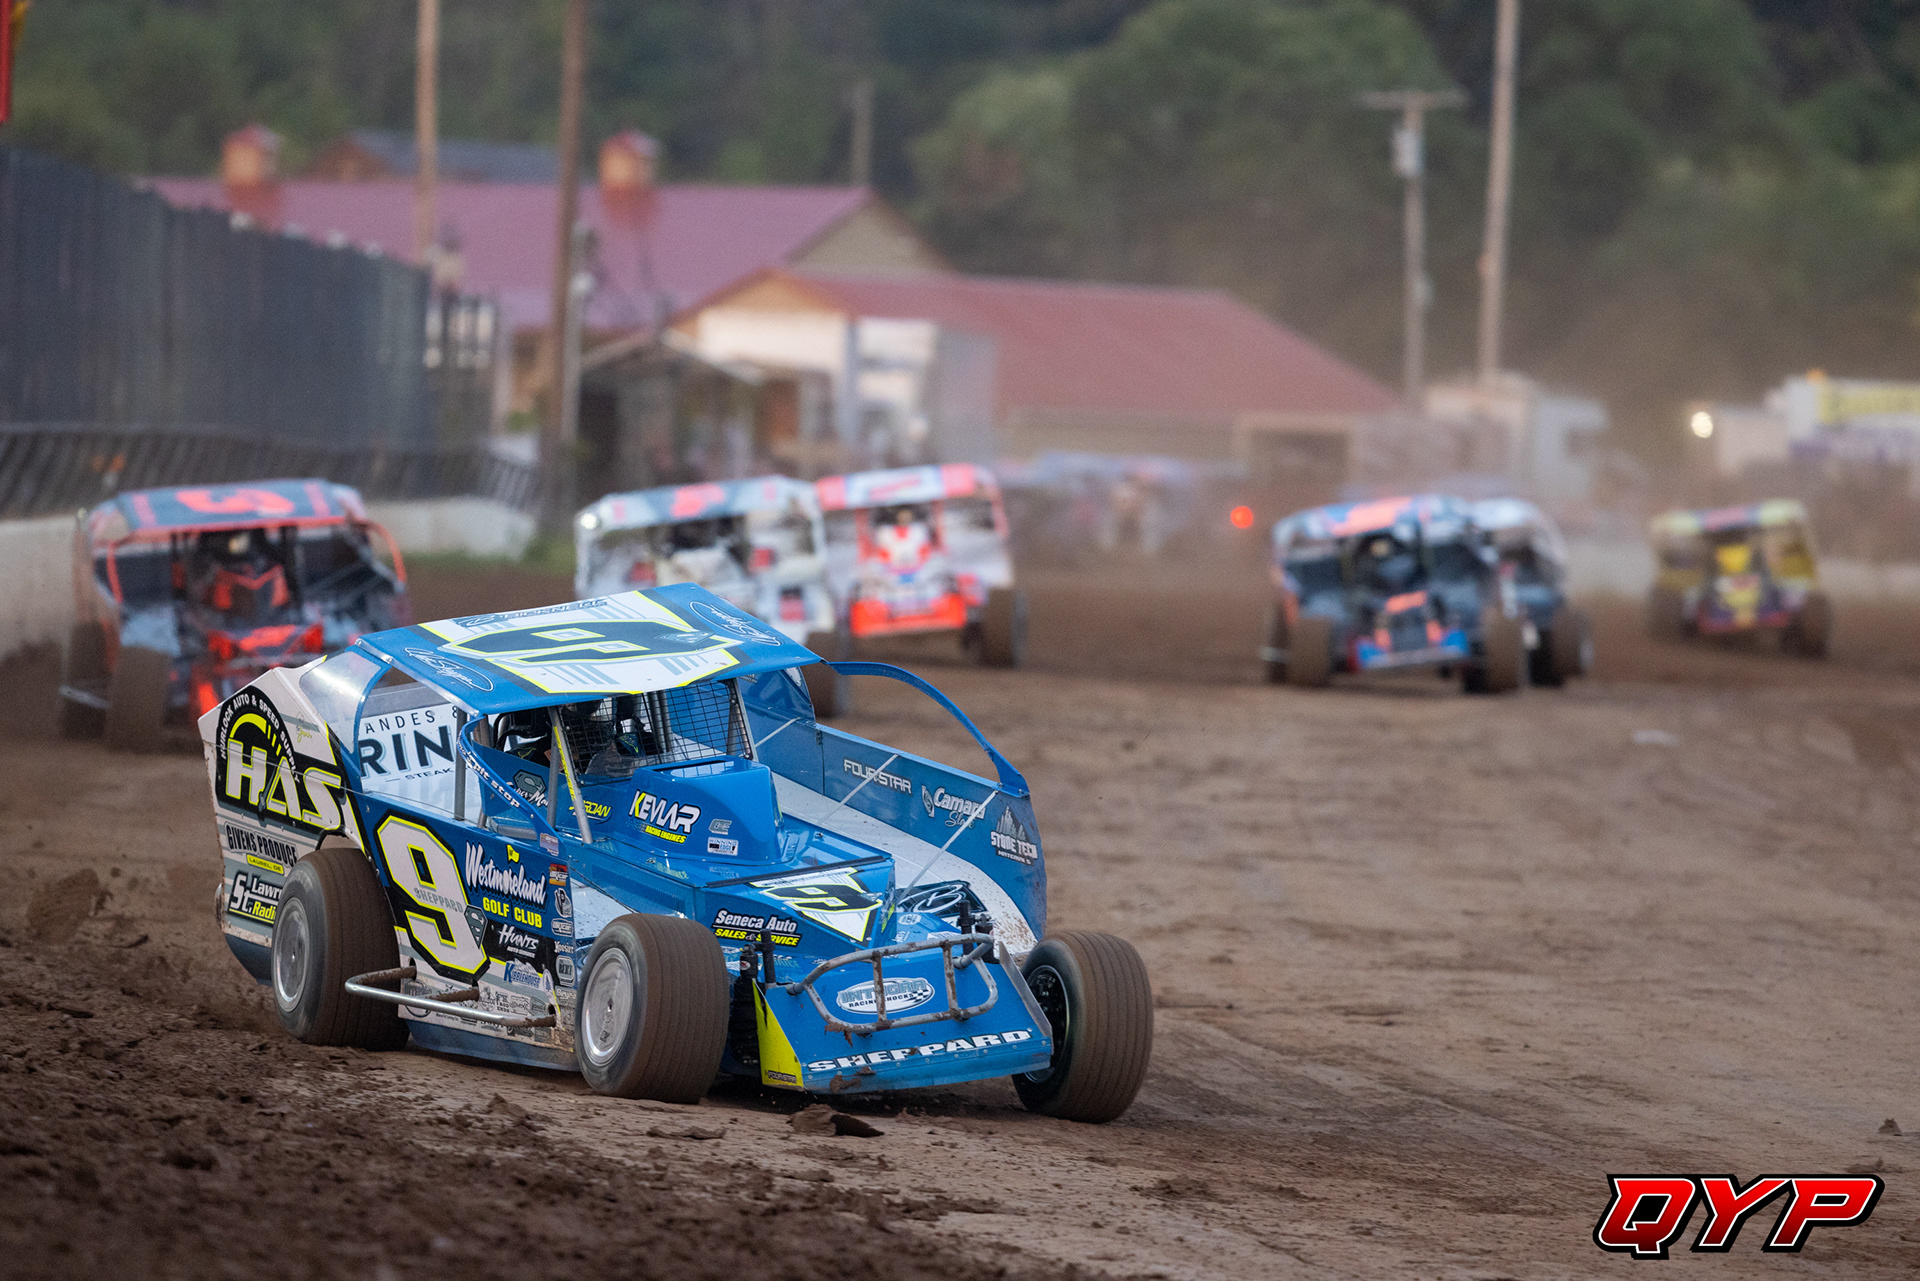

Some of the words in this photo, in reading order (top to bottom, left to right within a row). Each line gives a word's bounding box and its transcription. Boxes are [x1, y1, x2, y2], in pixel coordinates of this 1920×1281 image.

[220, 704, 234, 760] HURLOCK
[233, 693, 250, 711] AUTO
[251, 694, 257, 706] &
[259, 699, 280, 730] SPEED
[280, 731, 300, 783] SUPPLY
[226, 738, 341, 830] HAS
[629, 790, 700, 833] KEVLAR
[226, 824, 257, 853] GIVENS
[256, 835, 297, 867] PRODUCE
[661, 831, 687, 844] ENGINES
[991, 831, 1017, 853] STONE
[1017, 840, 1038, 859] TECH
[230, 873, 253, 914] St.
[465, 841, 548, 905] Westmoreland
[376, 814, 489, 976] 9
[414, 886, 464, 915] SHEPPARD
[482, 896, 510, 918] GOLF
[513, 906, 542, 929] CLUB
[714, 928, 747, 940] SALES
[756, 933, 800, 946] SRVICE
[715, 909, 765, 929] Seneca
[766, 917, 797, 933] Auto
[840, 980, 928, 1003] INTGRA
[808, 1030, 1034, 1073] SHEPPARD
